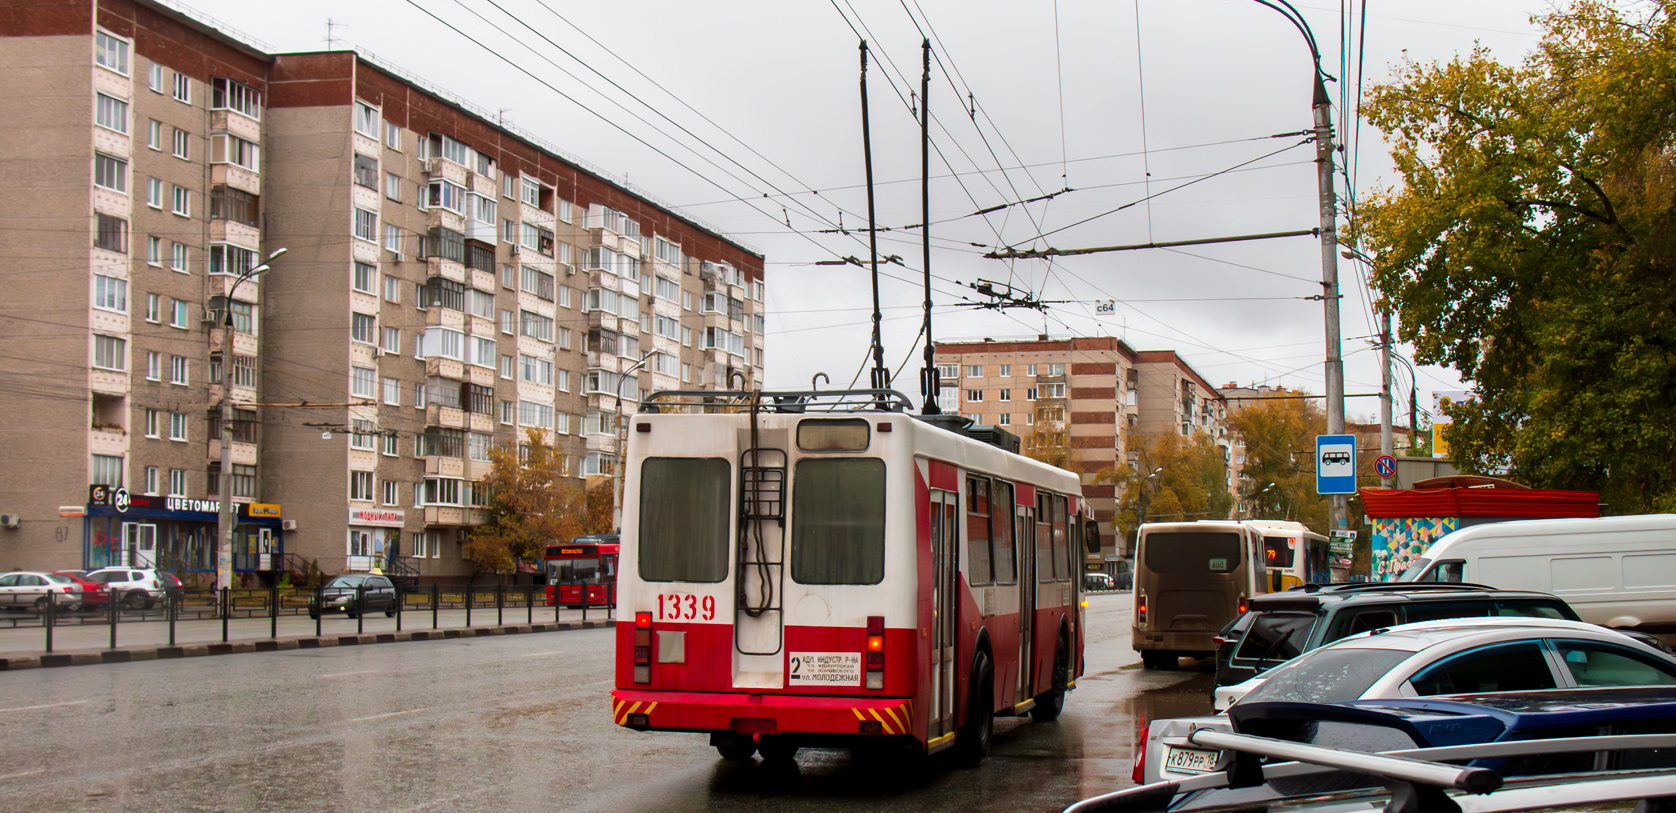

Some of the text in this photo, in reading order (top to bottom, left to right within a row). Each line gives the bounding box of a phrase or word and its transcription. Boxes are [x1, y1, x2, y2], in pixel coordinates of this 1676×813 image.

[117, 493, 128, 506] 24
[167, 497, 240, 514] ЦВЕТОМАРЕТ
[360, 510, 397, 522] МОДНЫЙ ПАПА
[1266, 549, 1277, 560] 79
[657, 593, 716, 621] 1339
[791, 656, 801, 679] 2
[812, 674, 859, 682] МОЛОДЕЖНАЯ
